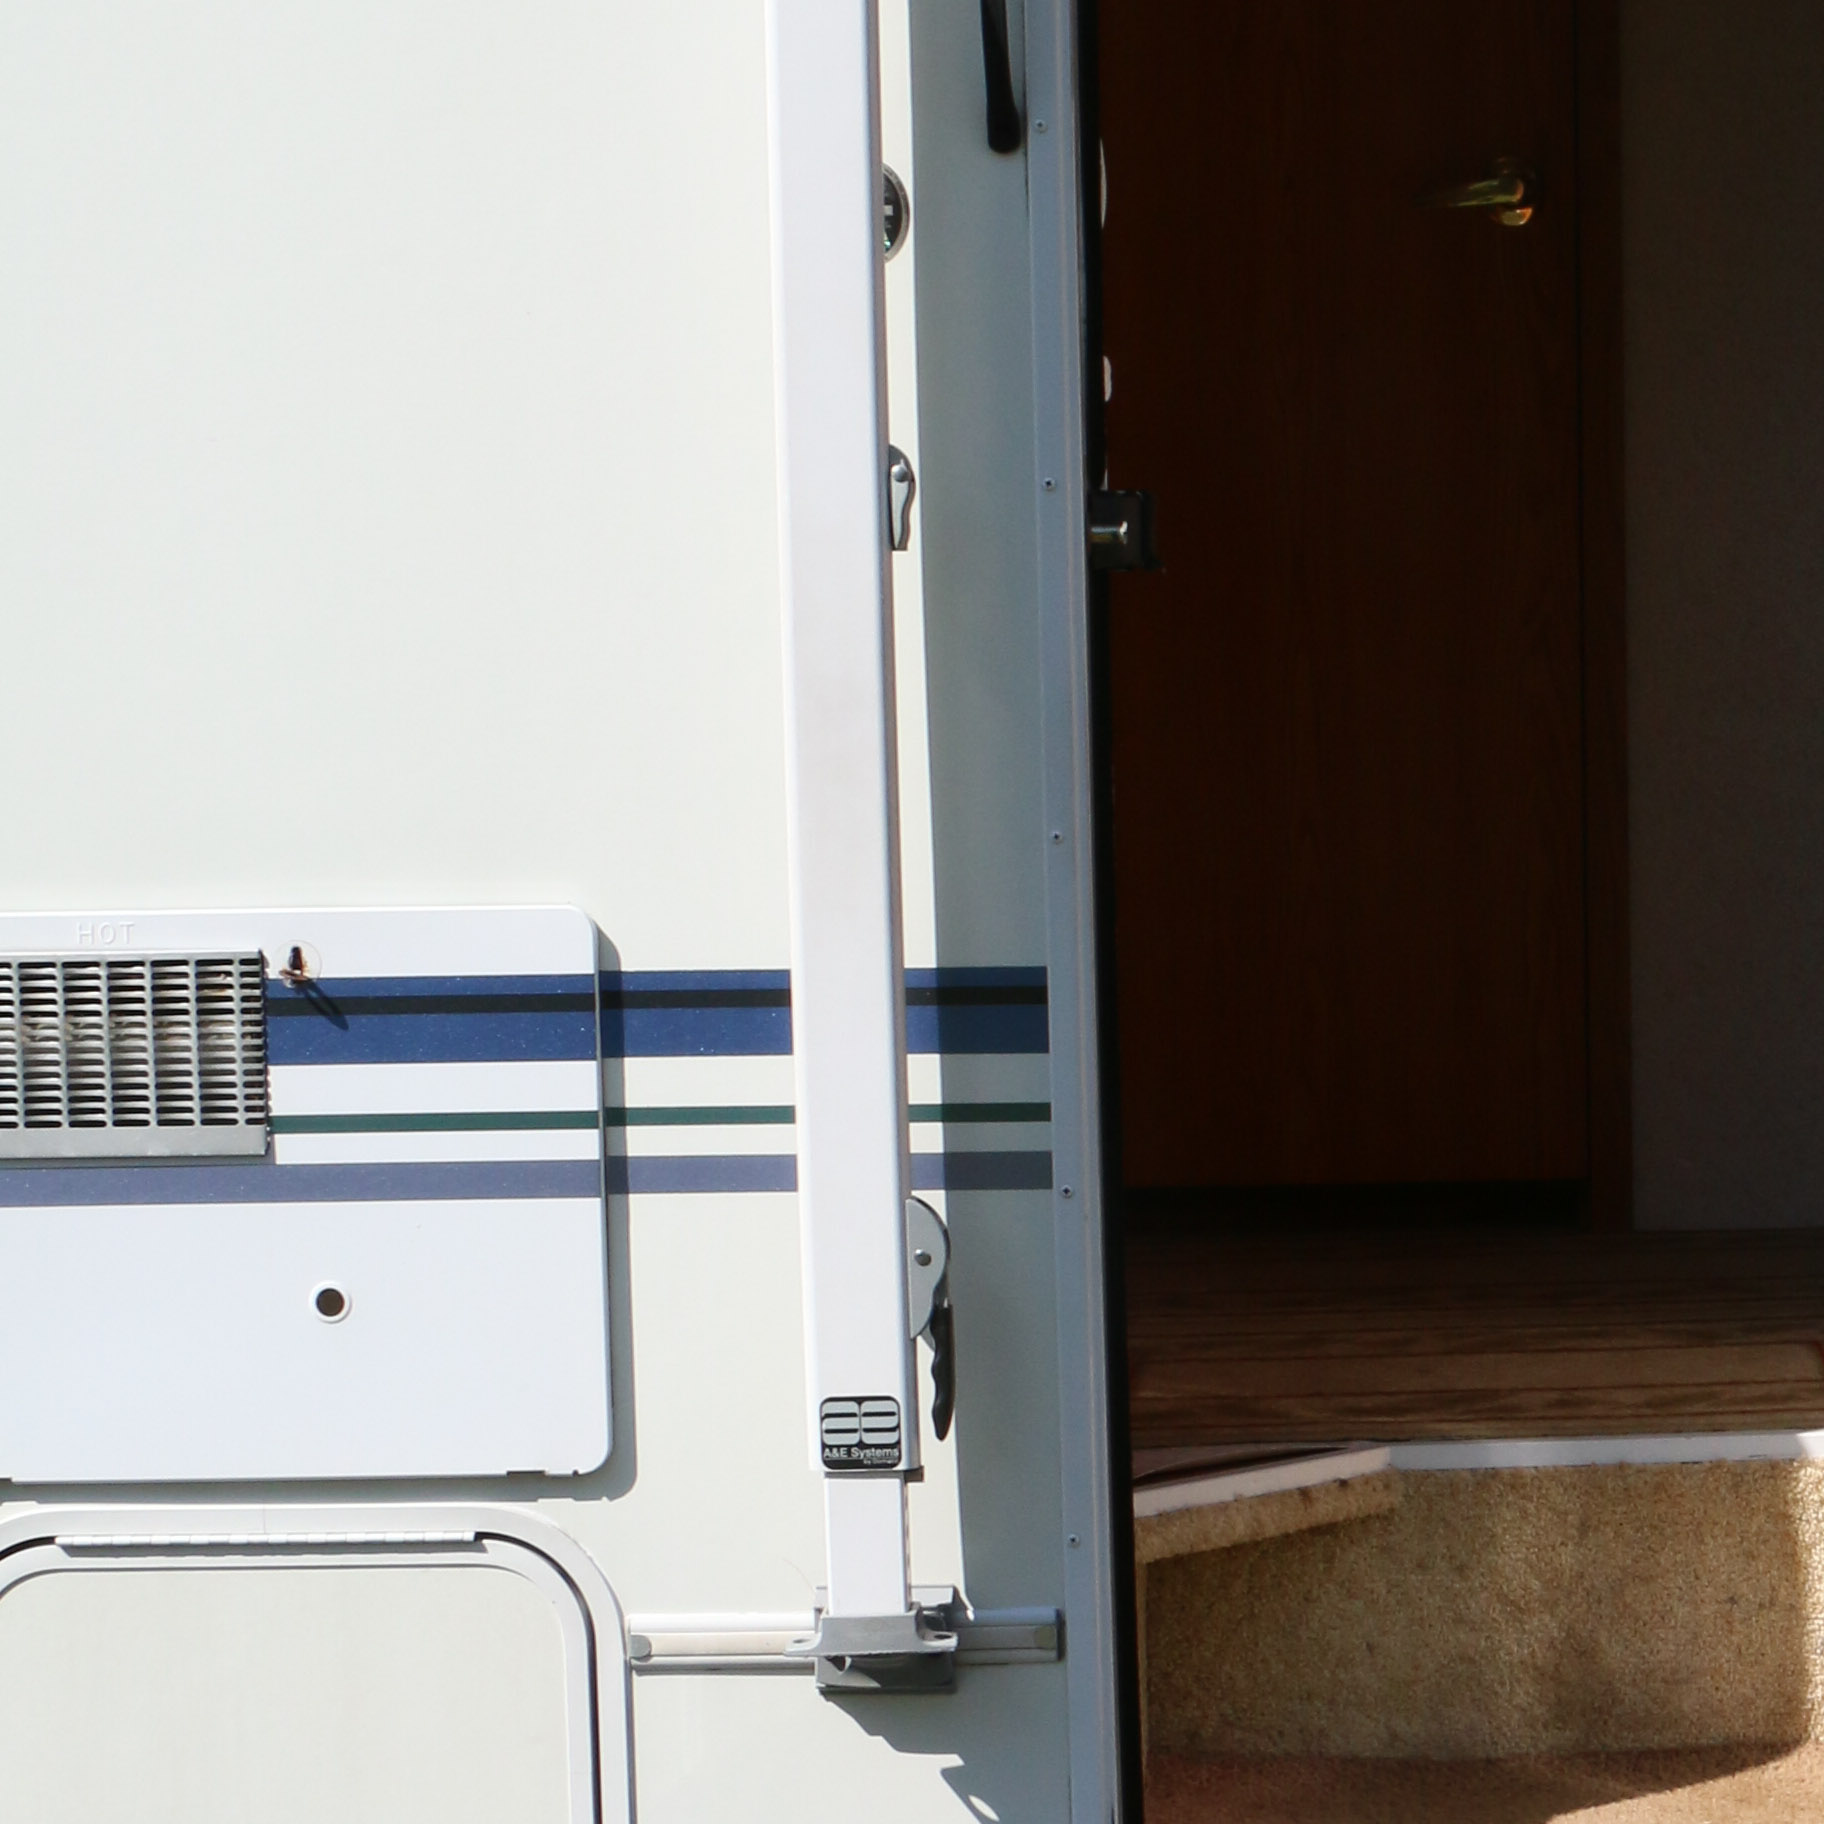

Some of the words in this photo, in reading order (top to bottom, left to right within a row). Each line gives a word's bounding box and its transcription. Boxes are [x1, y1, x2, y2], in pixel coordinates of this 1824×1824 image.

[76, 921, 136, 946] HOT
[823, 1447, 848, 1458] A&E
[850, 1446, 899, 1459] Systems
